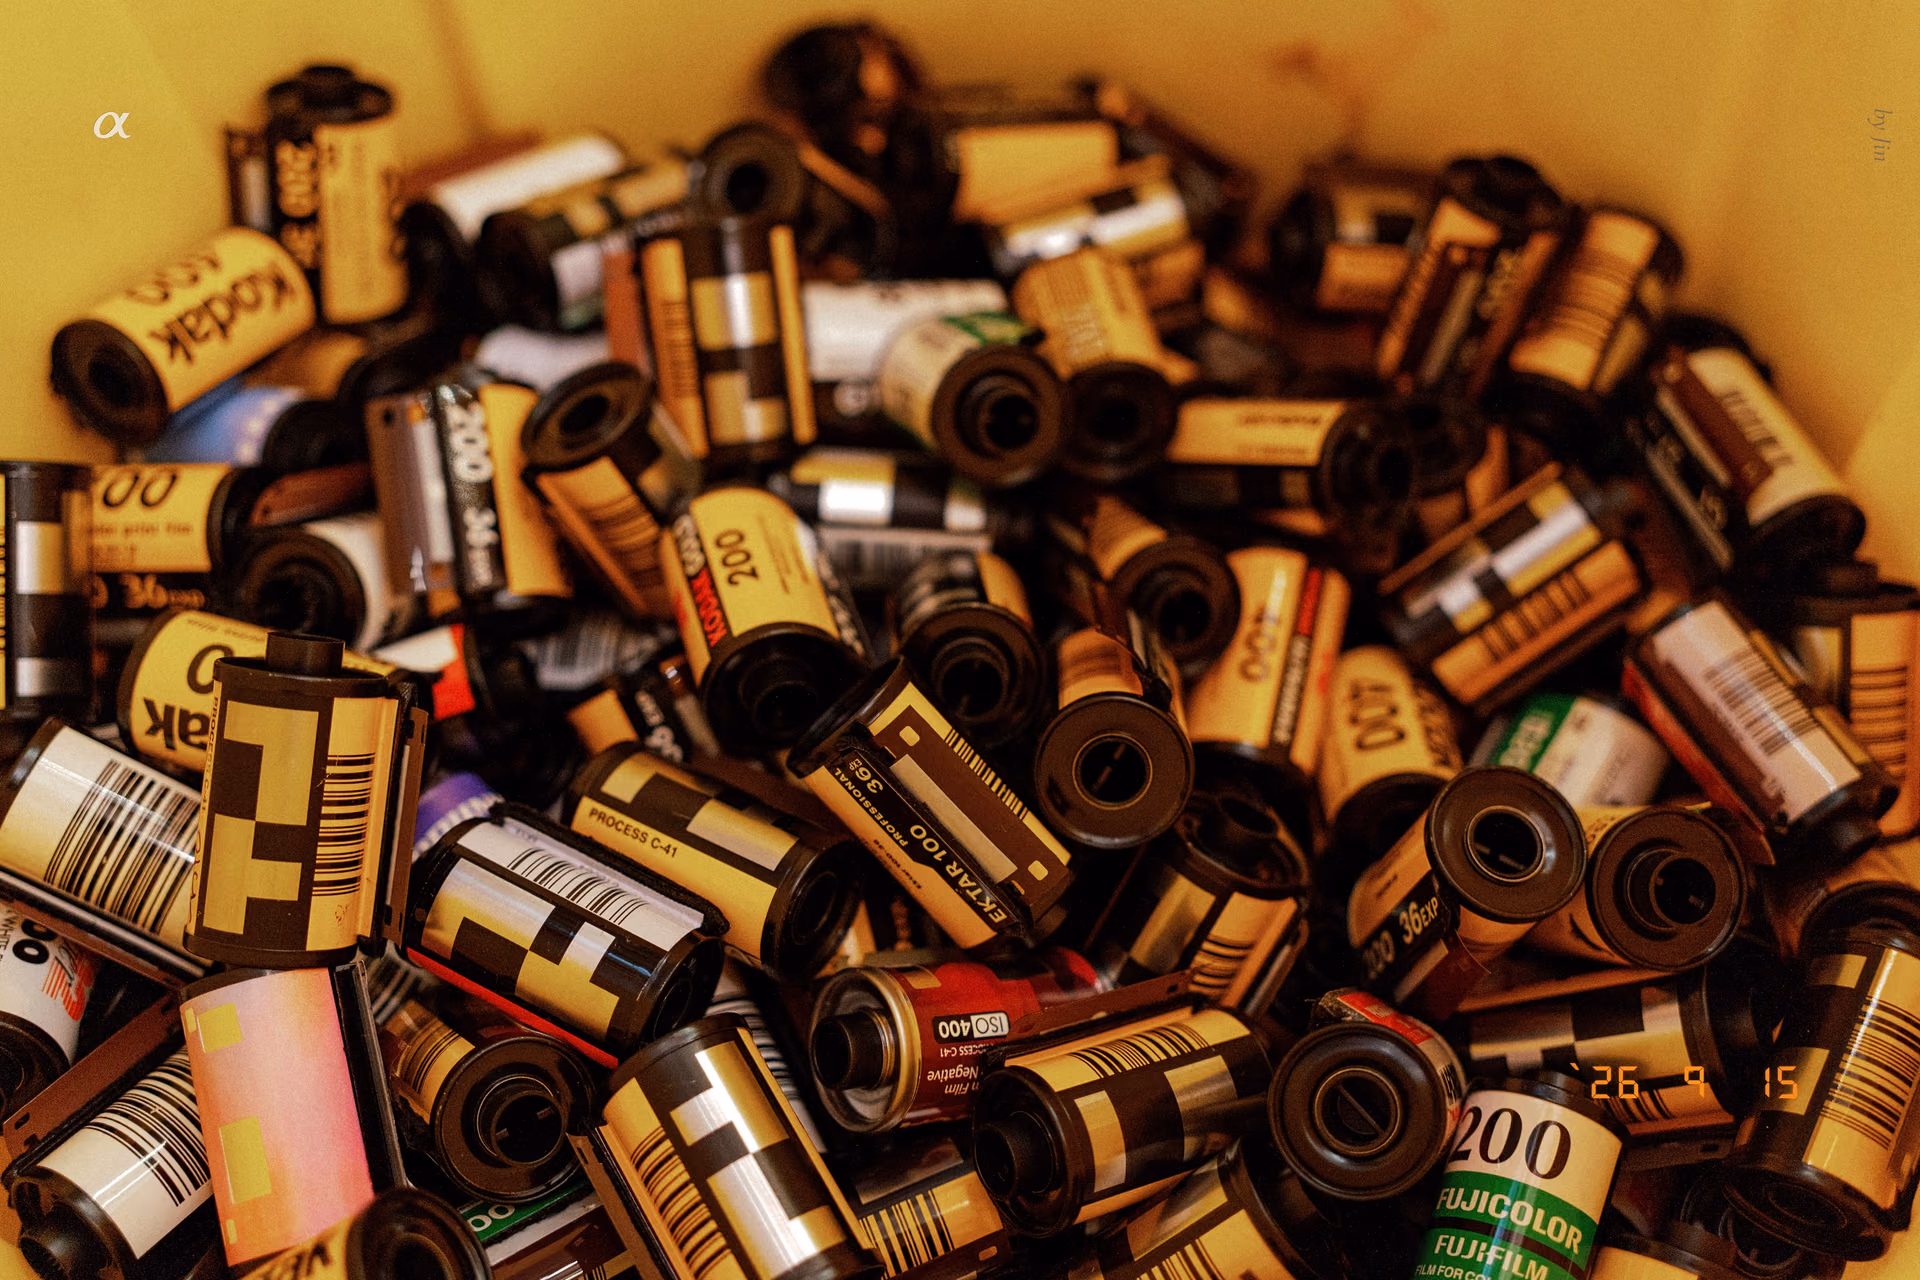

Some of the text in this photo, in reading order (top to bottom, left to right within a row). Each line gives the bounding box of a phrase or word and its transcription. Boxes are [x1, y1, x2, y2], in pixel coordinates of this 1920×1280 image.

[149, 263, 291, 365] Kodak
[714, 528, 760, 588] 200
[855, 766, 884, 794] 36
[834, 767, 909, 848] PROFESSIONAL
[588, 807, 678, 858] PROCESS C-41
[910, 824, 1008, 924] EKTAR 100
[938, 1016, 1004, 1039] ISO 400
[927, 1064, 980, 1083] Negative
[940, 1046, 958, 1058] C-41
[944, 1082, 970, 1096] Film
[1448, 1105, 1572, 1180] 200
[1435, 1187, 1583, 1255] FUJICOLOR
[1434, 1234, 1549, 1280] FUJIFILM
[1436, 1265, 1465, 1280] FOR
